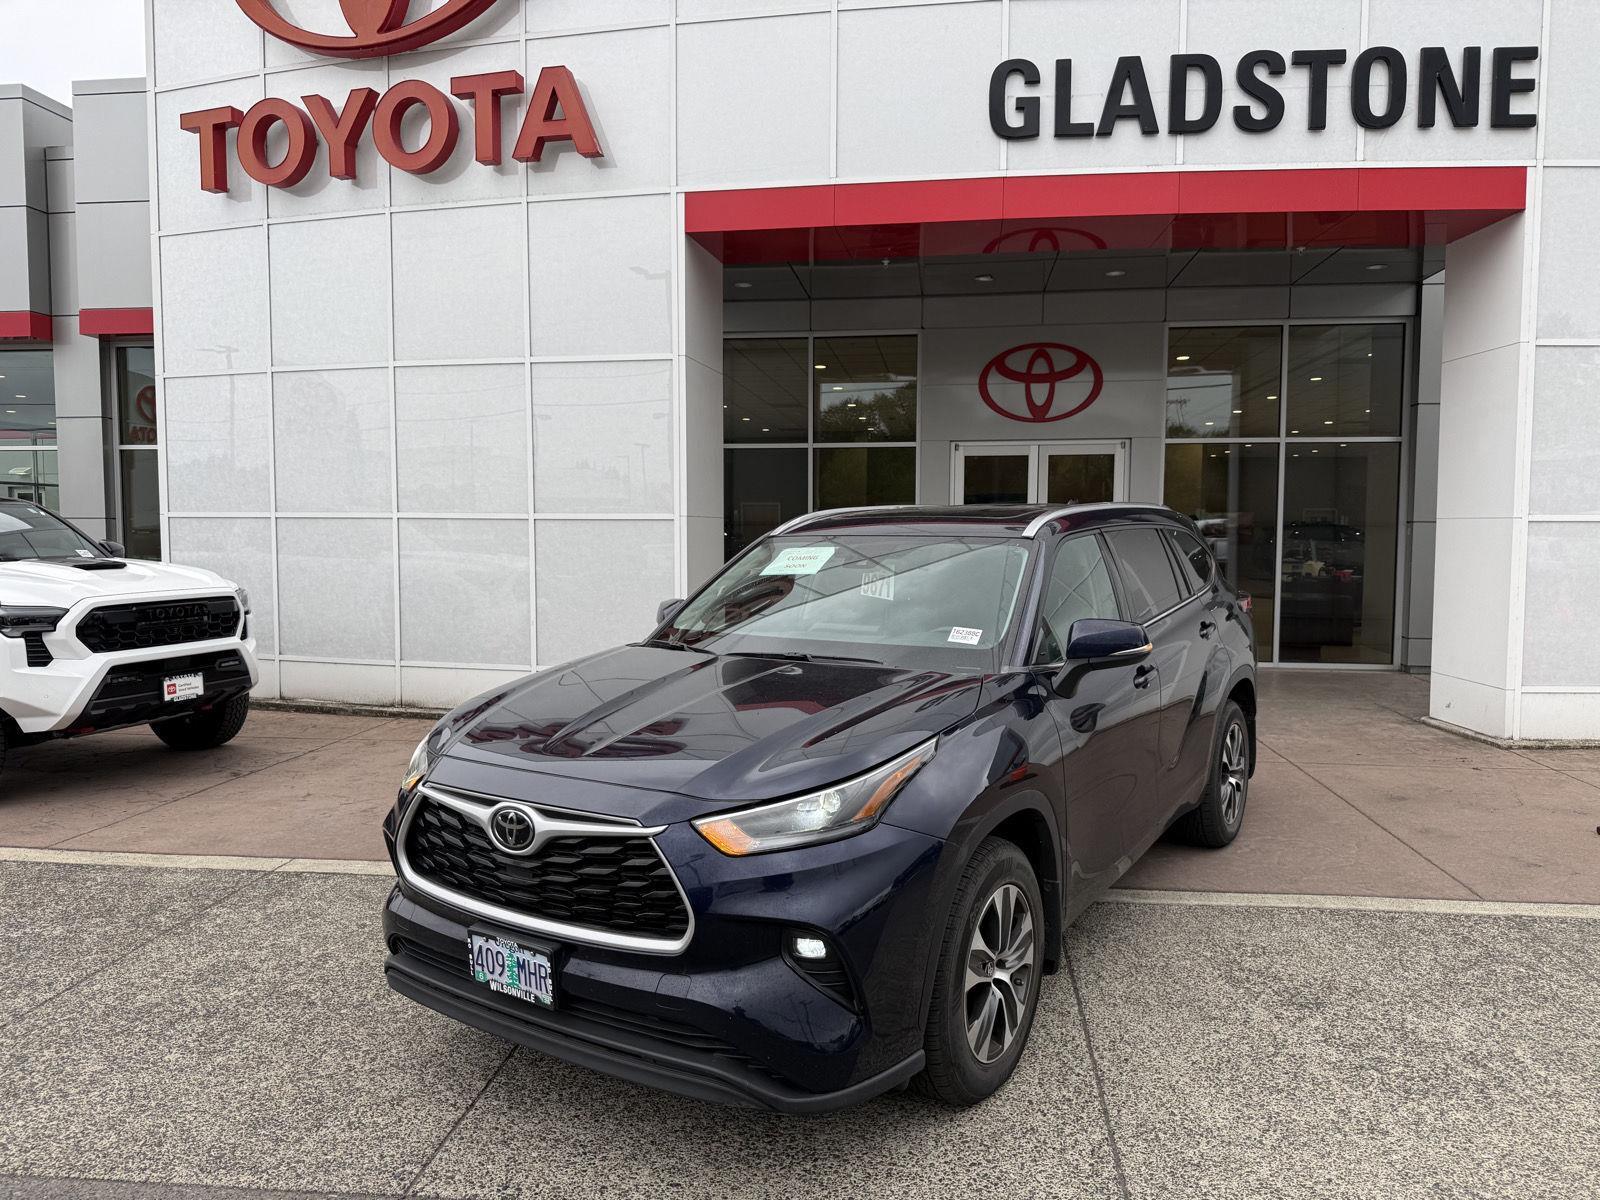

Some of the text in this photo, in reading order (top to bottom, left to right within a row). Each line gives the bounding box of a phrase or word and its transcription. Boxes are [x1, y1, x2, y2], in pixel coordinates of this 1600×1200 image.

[988, 46, 1539, 140] GLADSTONE
[180, 65, 604, 194] TOYOTA
[786, 554, 820, 562] COMING
[146, 605, 200, 619] TOYOTA
[475, 944, 549, 994] 409 MHR
[489, 979, 536, 1004] WILSONVILLE
